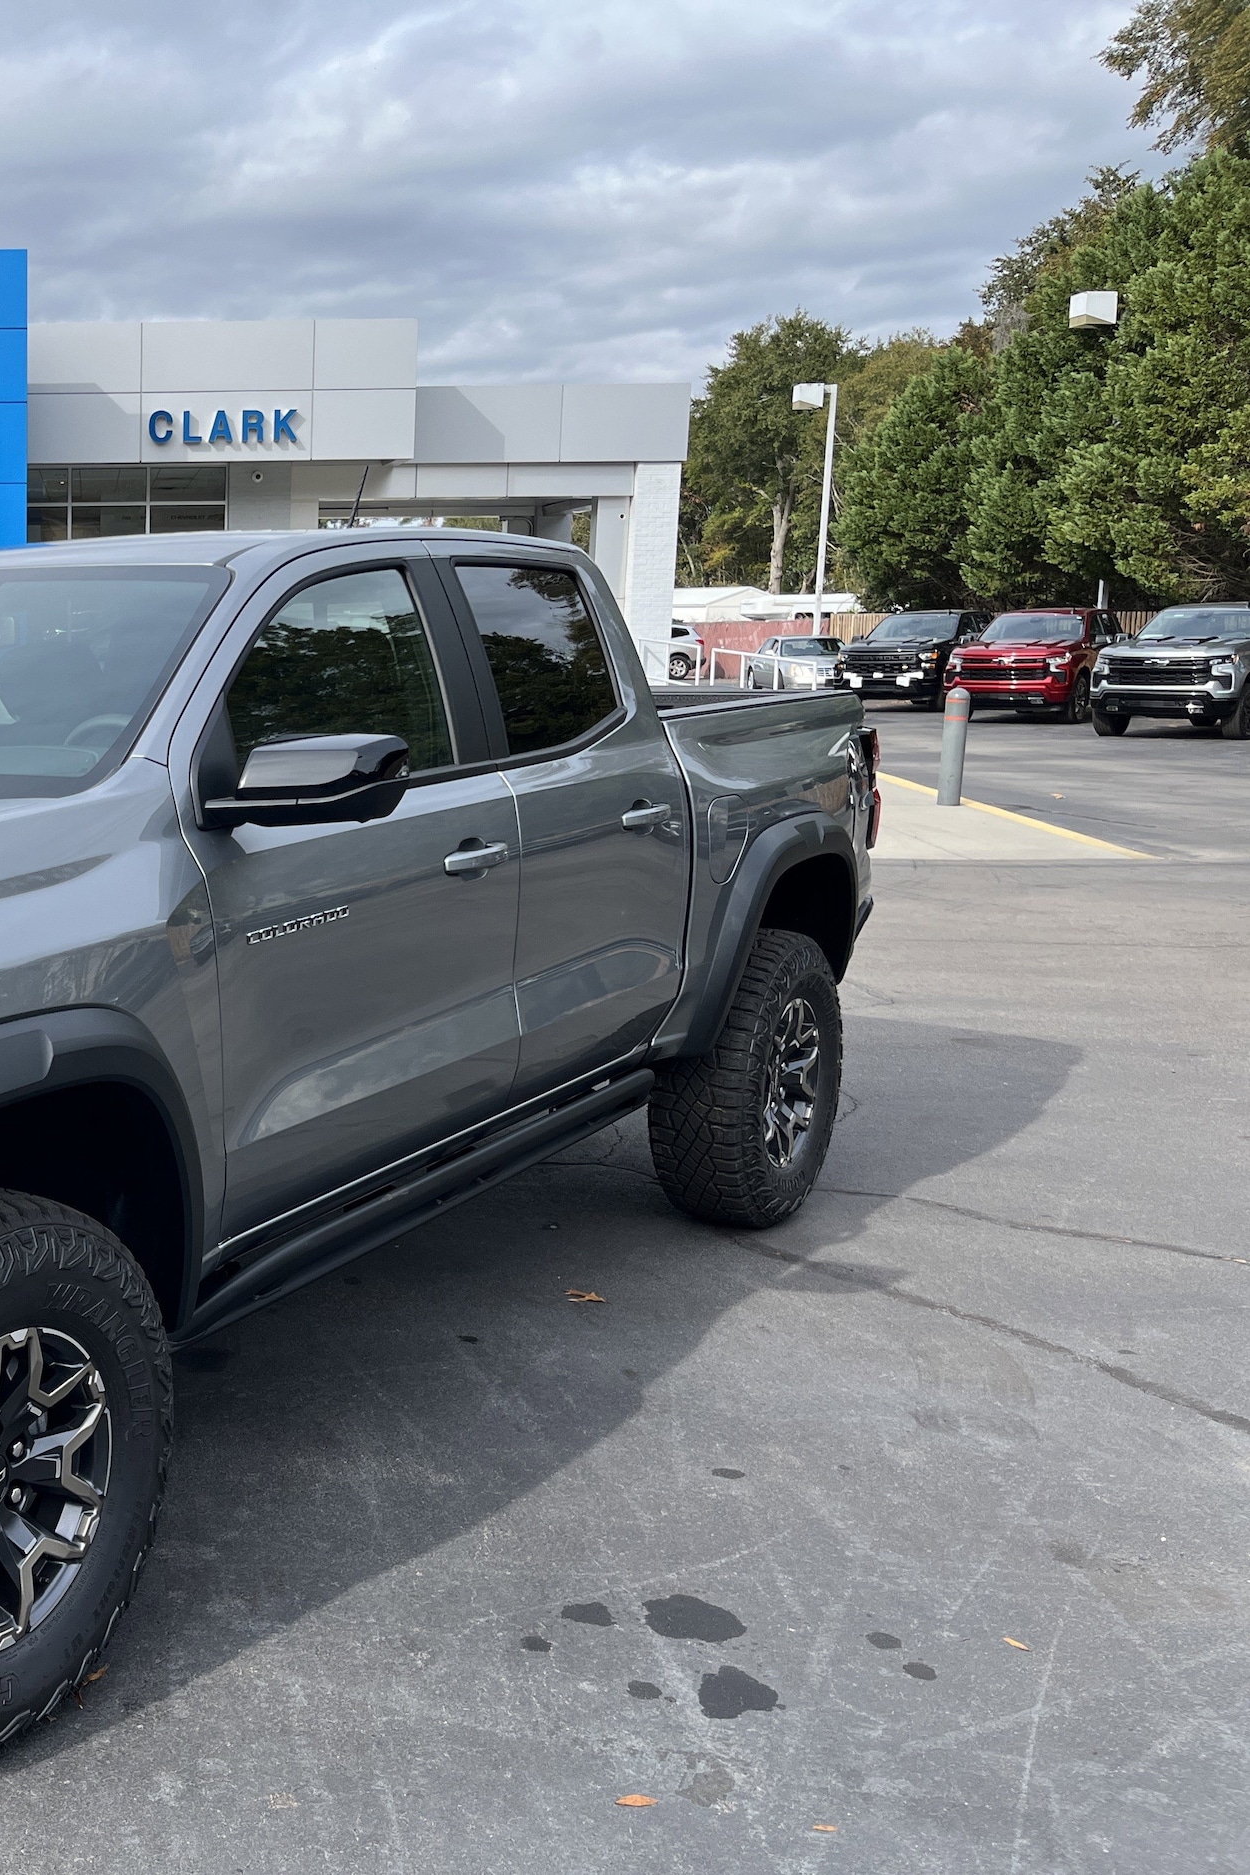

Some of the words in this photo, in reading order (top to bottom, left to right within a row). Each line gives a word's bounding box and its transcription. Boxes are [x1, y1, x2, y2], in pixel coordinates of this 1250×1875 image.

[148, 409, 299, 444] CLARK
[246, 904, 350, 945] COLORADO
[40, 1282, 154, 1438] WRANGLER
